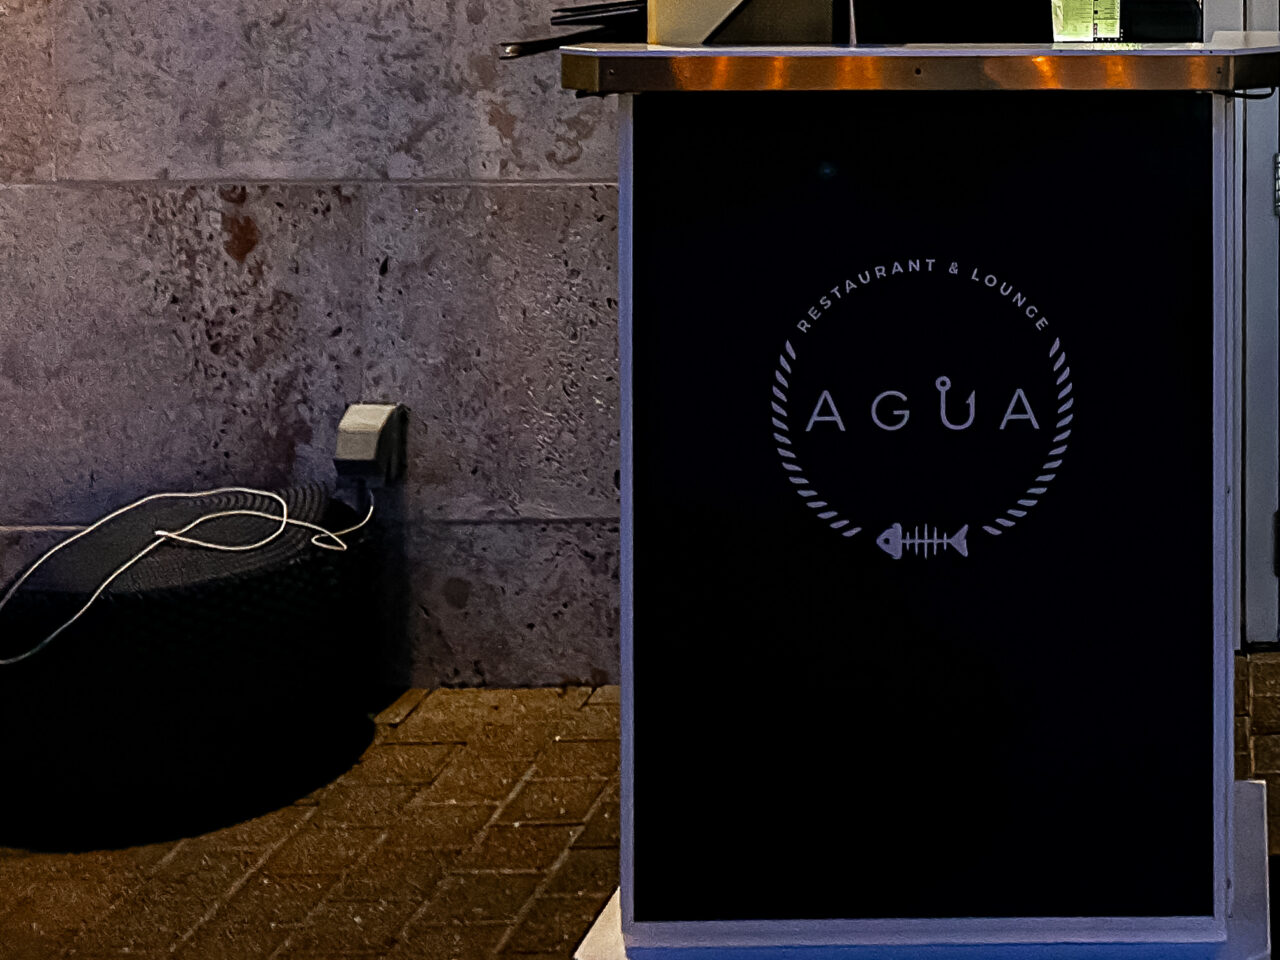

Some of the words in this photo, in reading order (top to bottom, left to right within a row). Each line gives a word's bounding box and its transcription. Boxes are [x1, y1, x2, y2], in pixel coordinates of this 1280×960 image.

[797, 258, 936, 333] RESTAURANT
[948, 261, 959, 275] &
[971, 267, 1049, 332] LOUNGE
[805, 375, 1040, 432] AGUA
